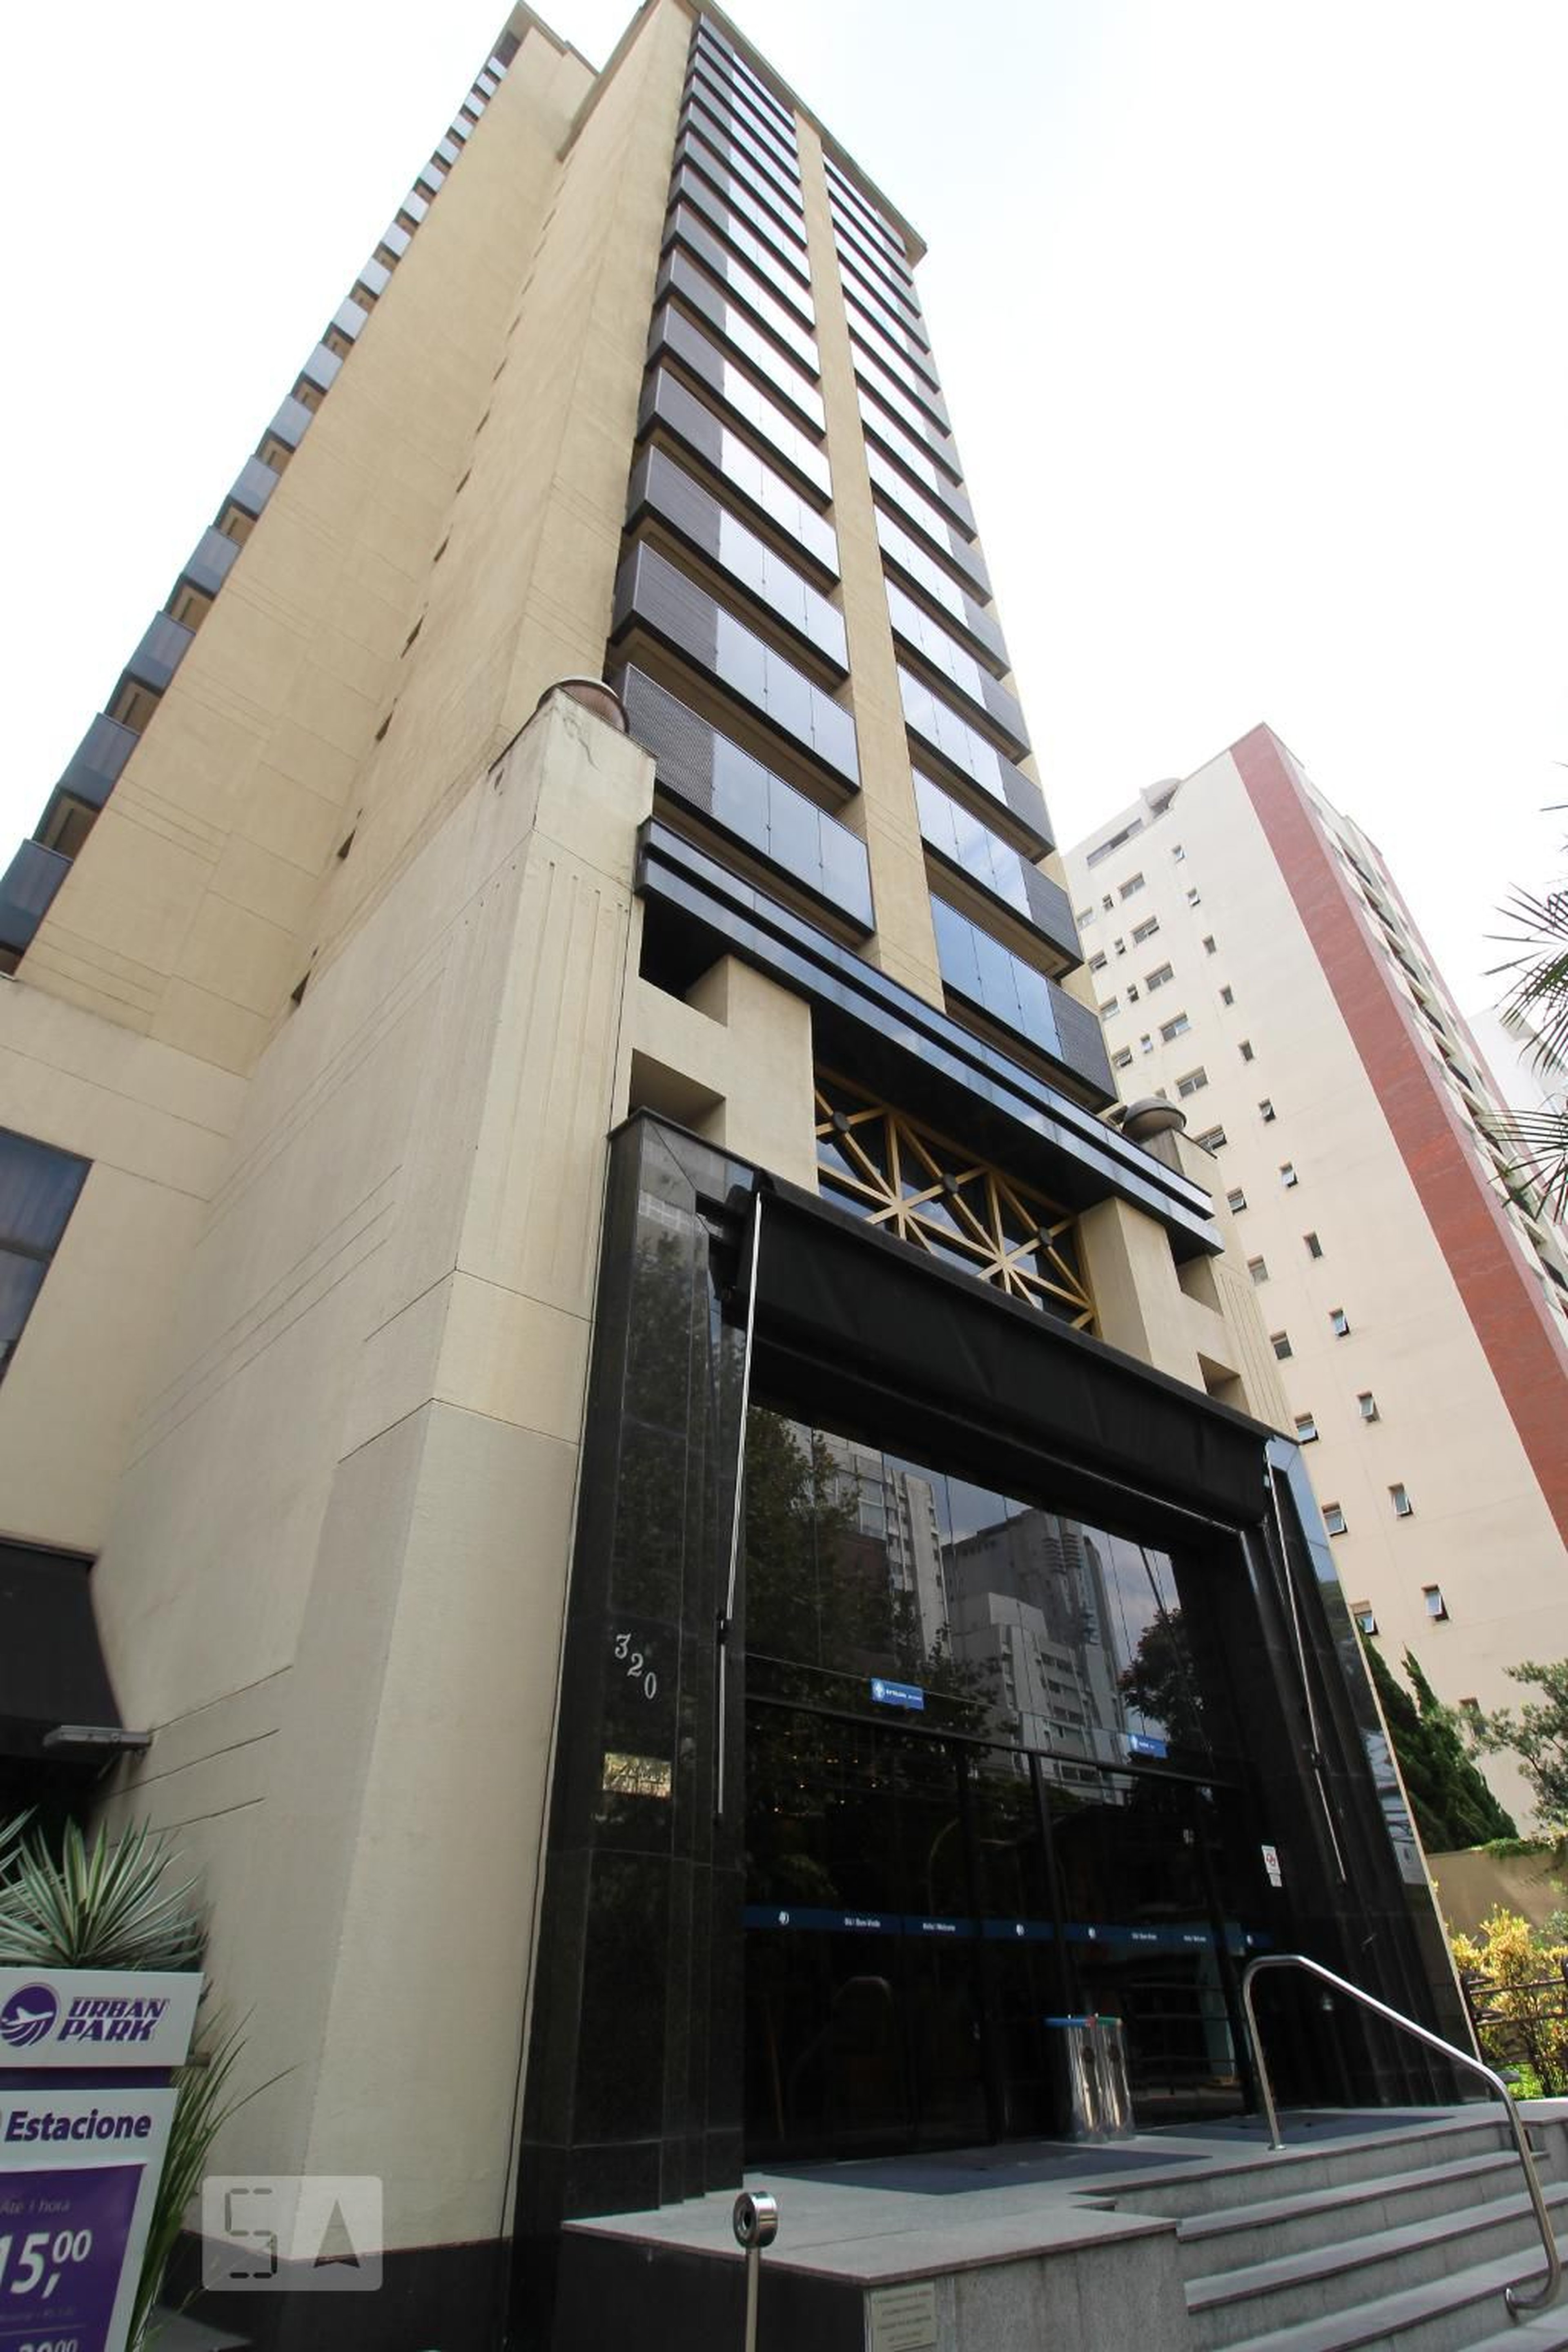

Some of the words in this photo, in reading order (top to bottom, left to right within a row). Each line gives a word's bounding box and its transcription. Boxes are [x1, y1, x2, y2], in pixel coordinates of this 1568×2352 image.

[615, 1633, 657, 1699] 320
[69, 1999, 166, 2018] URBAN
[57, 2019, 158, 2041] PARK
[4, 2109, 151, 2142] Estacione
